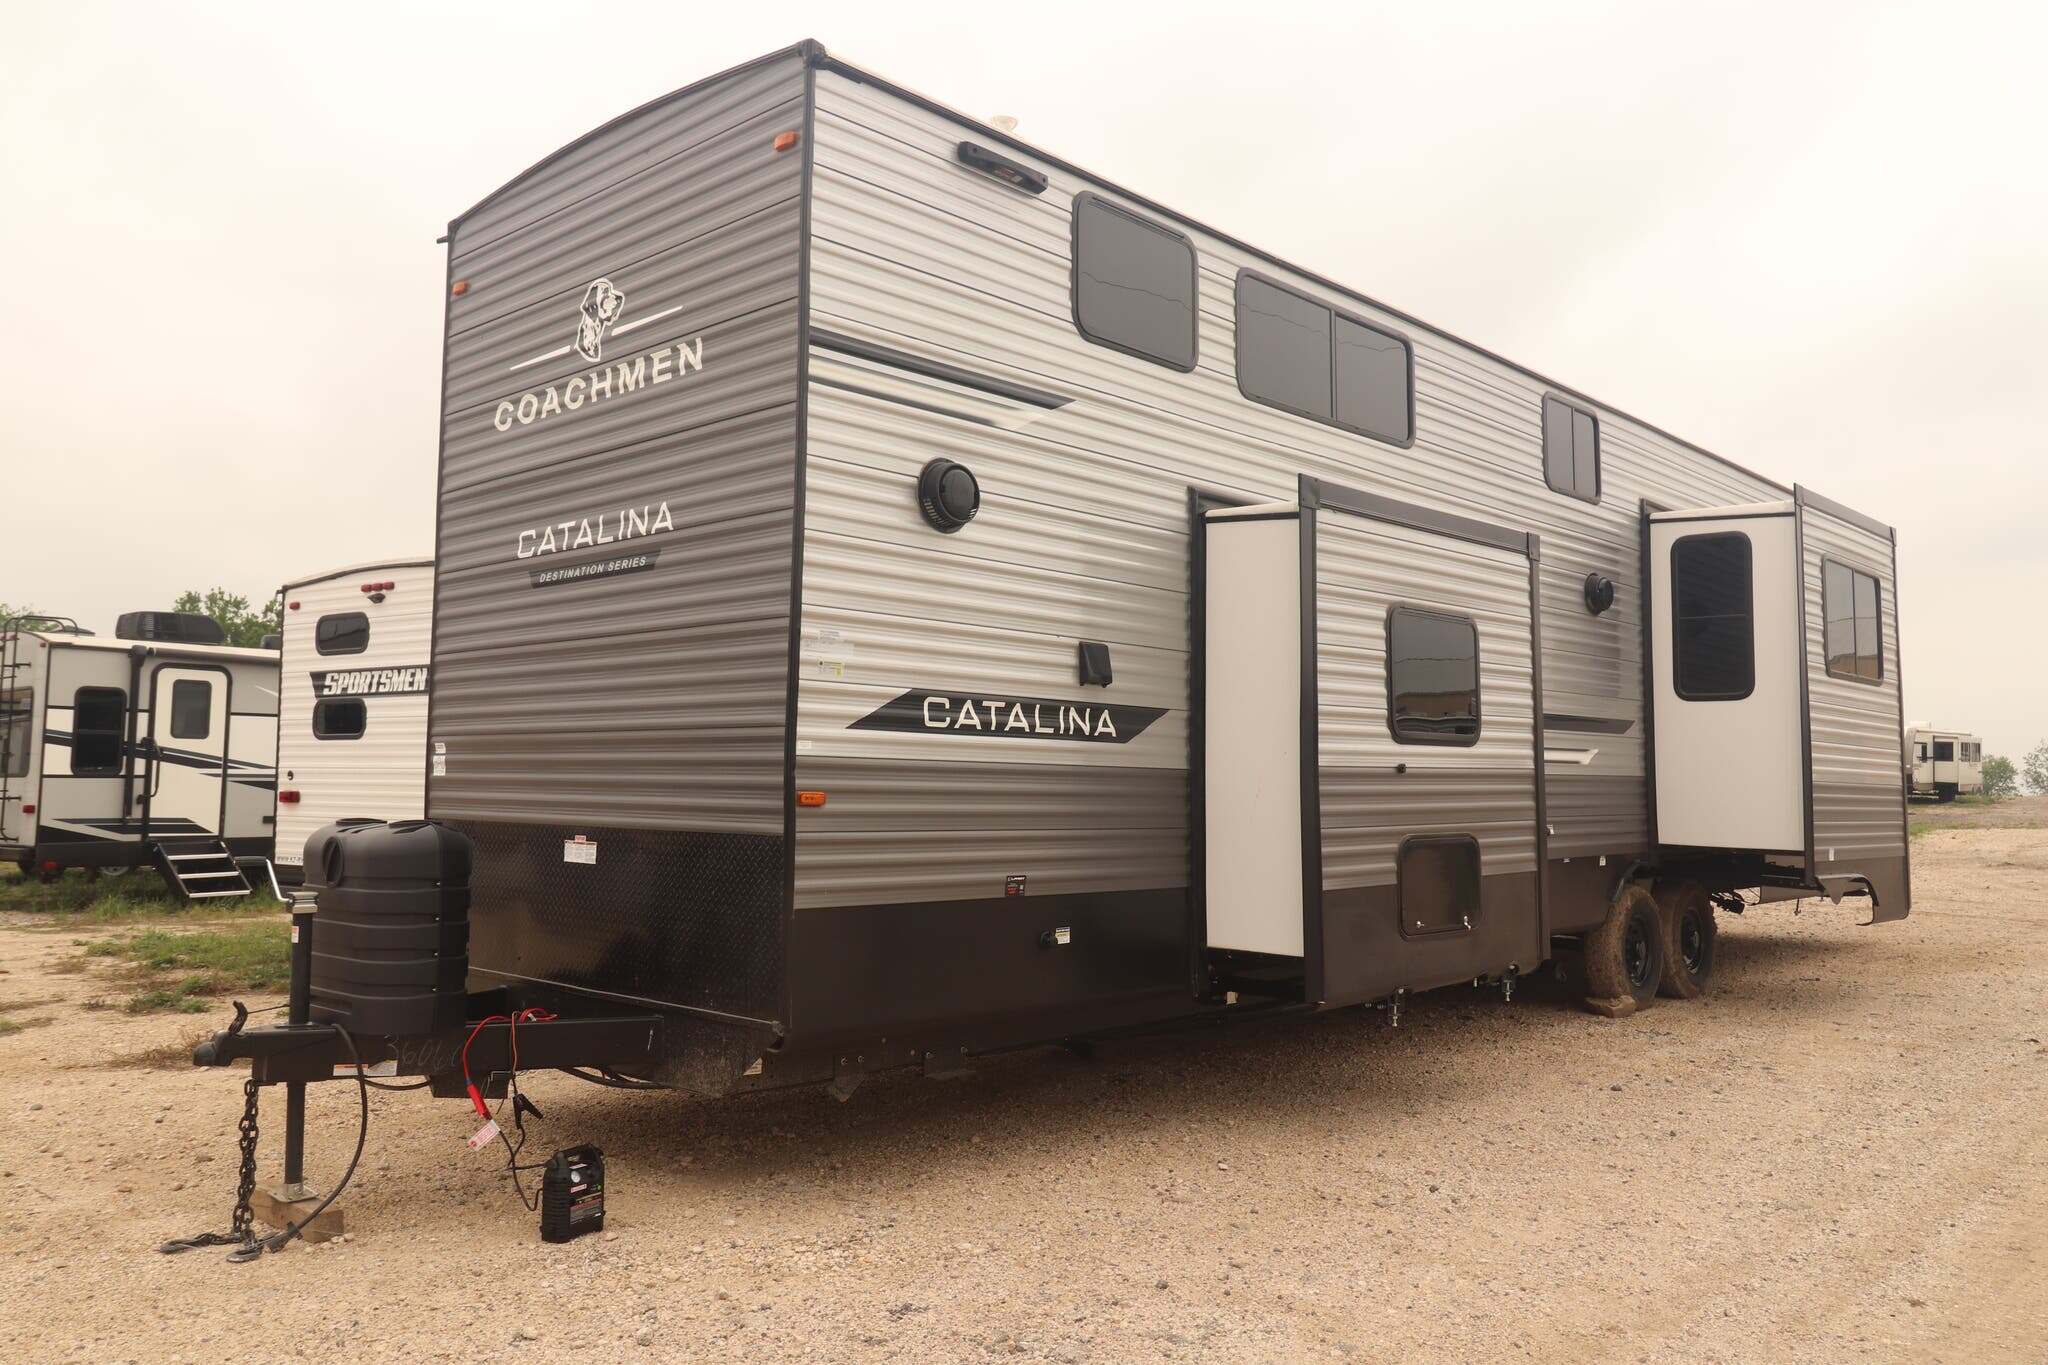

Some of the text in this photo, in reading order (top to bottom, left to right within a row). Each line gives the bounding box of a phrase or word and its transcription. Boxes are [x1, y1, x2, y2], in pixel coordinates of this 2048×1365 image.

[494, 337, 703, 432] COACHMEN
[516, 501, 675, 559] CATALINA
[539, 556, 647, 583] DESTINATION SERIES
[323, 667, 428, 696] SPORTSMEN
[923, 696, 1117, 738] CATALINA
